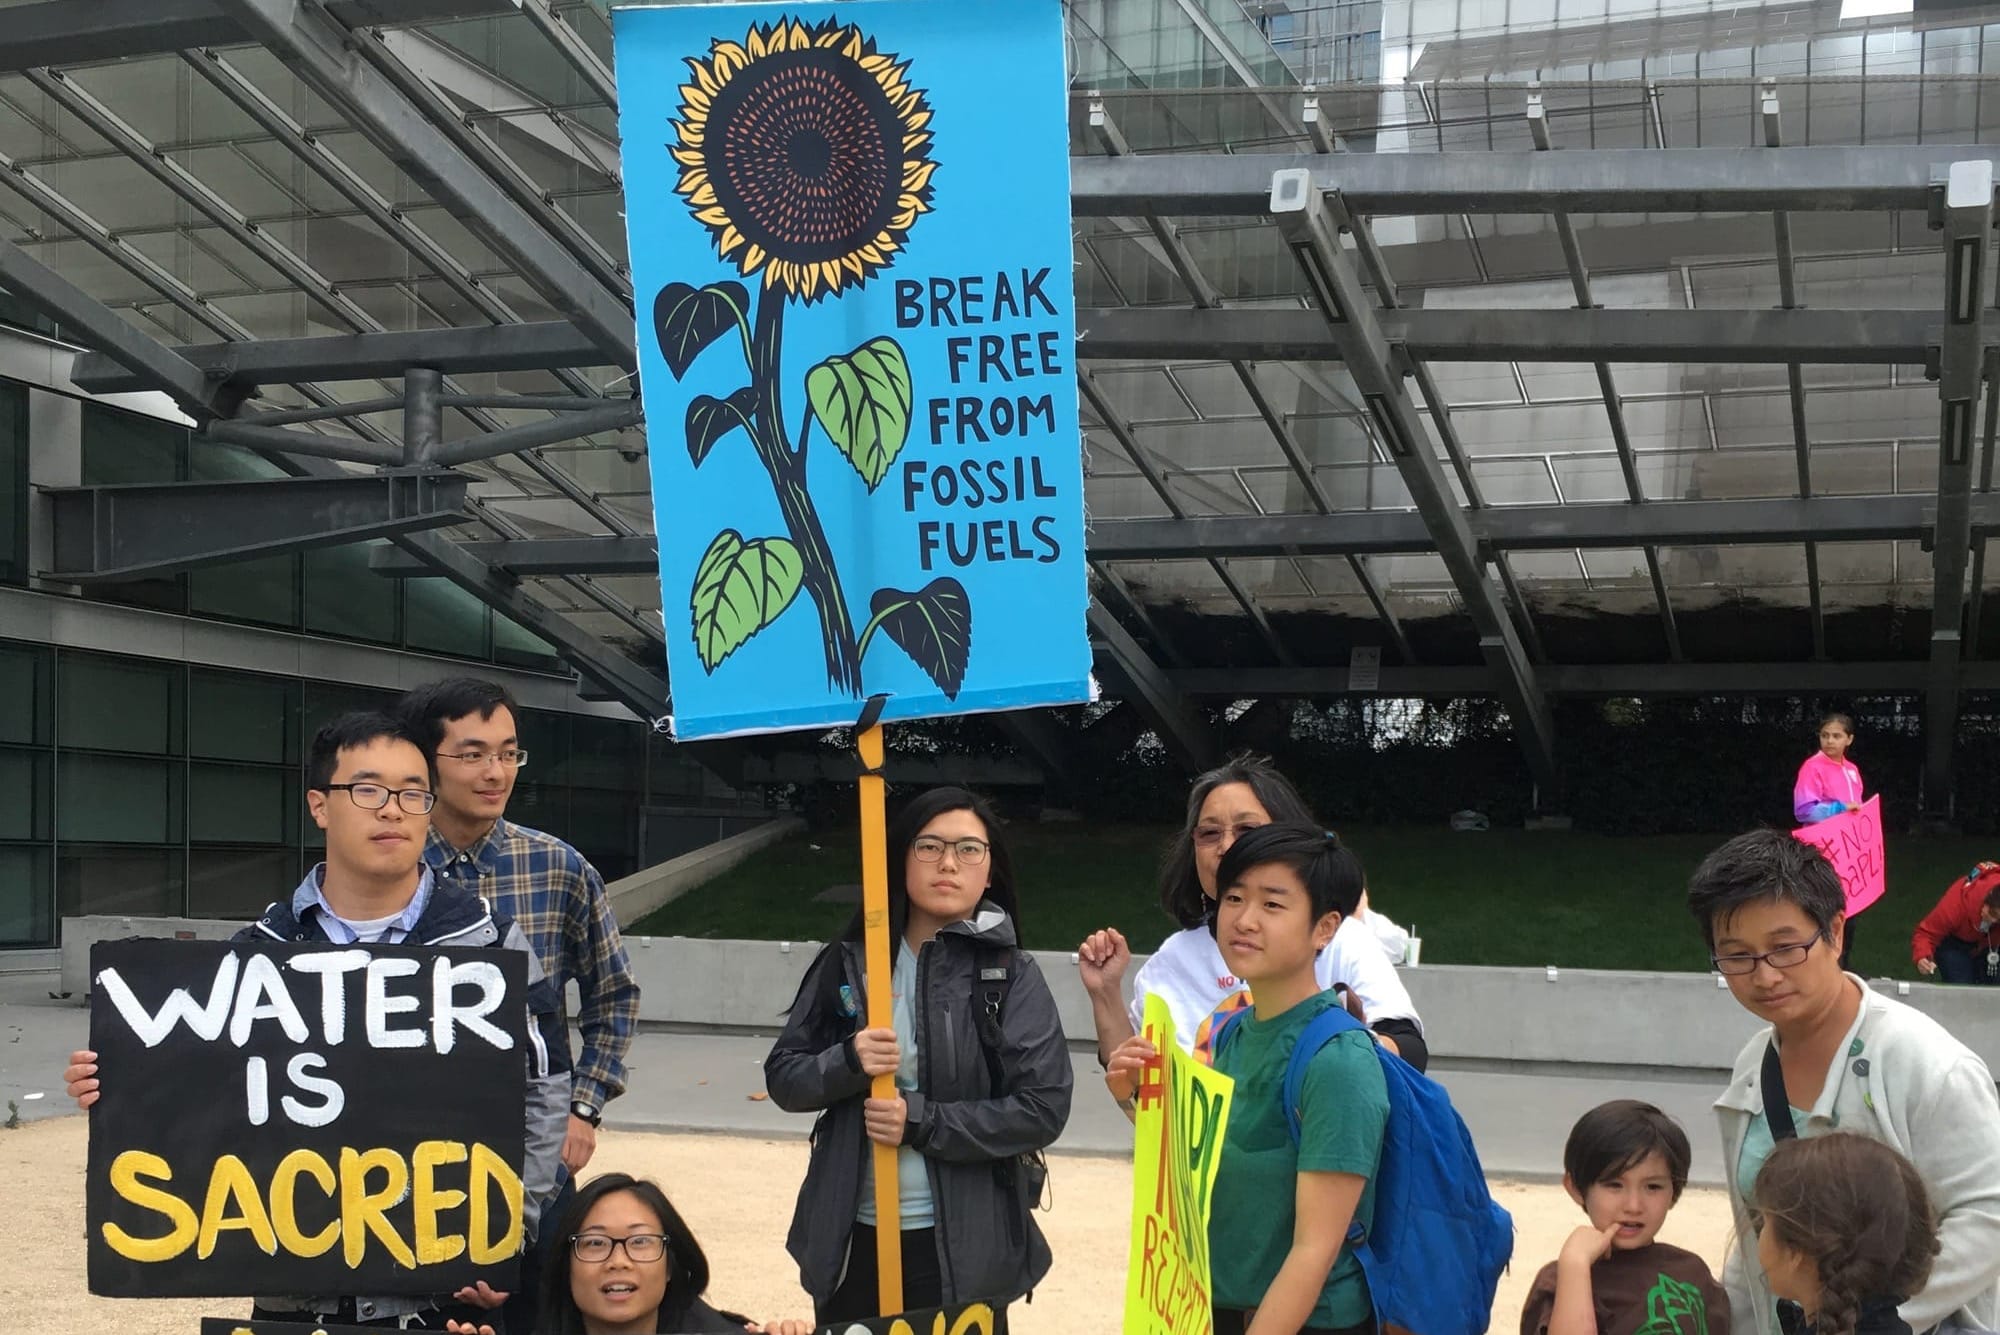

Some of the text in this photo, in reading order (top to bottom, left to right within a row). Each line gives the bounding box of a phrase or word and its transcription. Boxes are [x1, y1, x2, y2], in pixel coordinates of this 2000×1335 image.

[895, 267, 1058, 328] BREAK
[947, 331, 1062, 383] FREE
[928, 394, 1056, 445] FROM
[903, 456, 1057, 512] FOSSIL
[918, 516, 1061, 571] FUELS
[1821, 814, 1873, 865] #NO
[96, 949, 514, 1054] WATER
[246, 1052, 345, 1127] IS
[102, 1140, 525, 1269] SACRED
